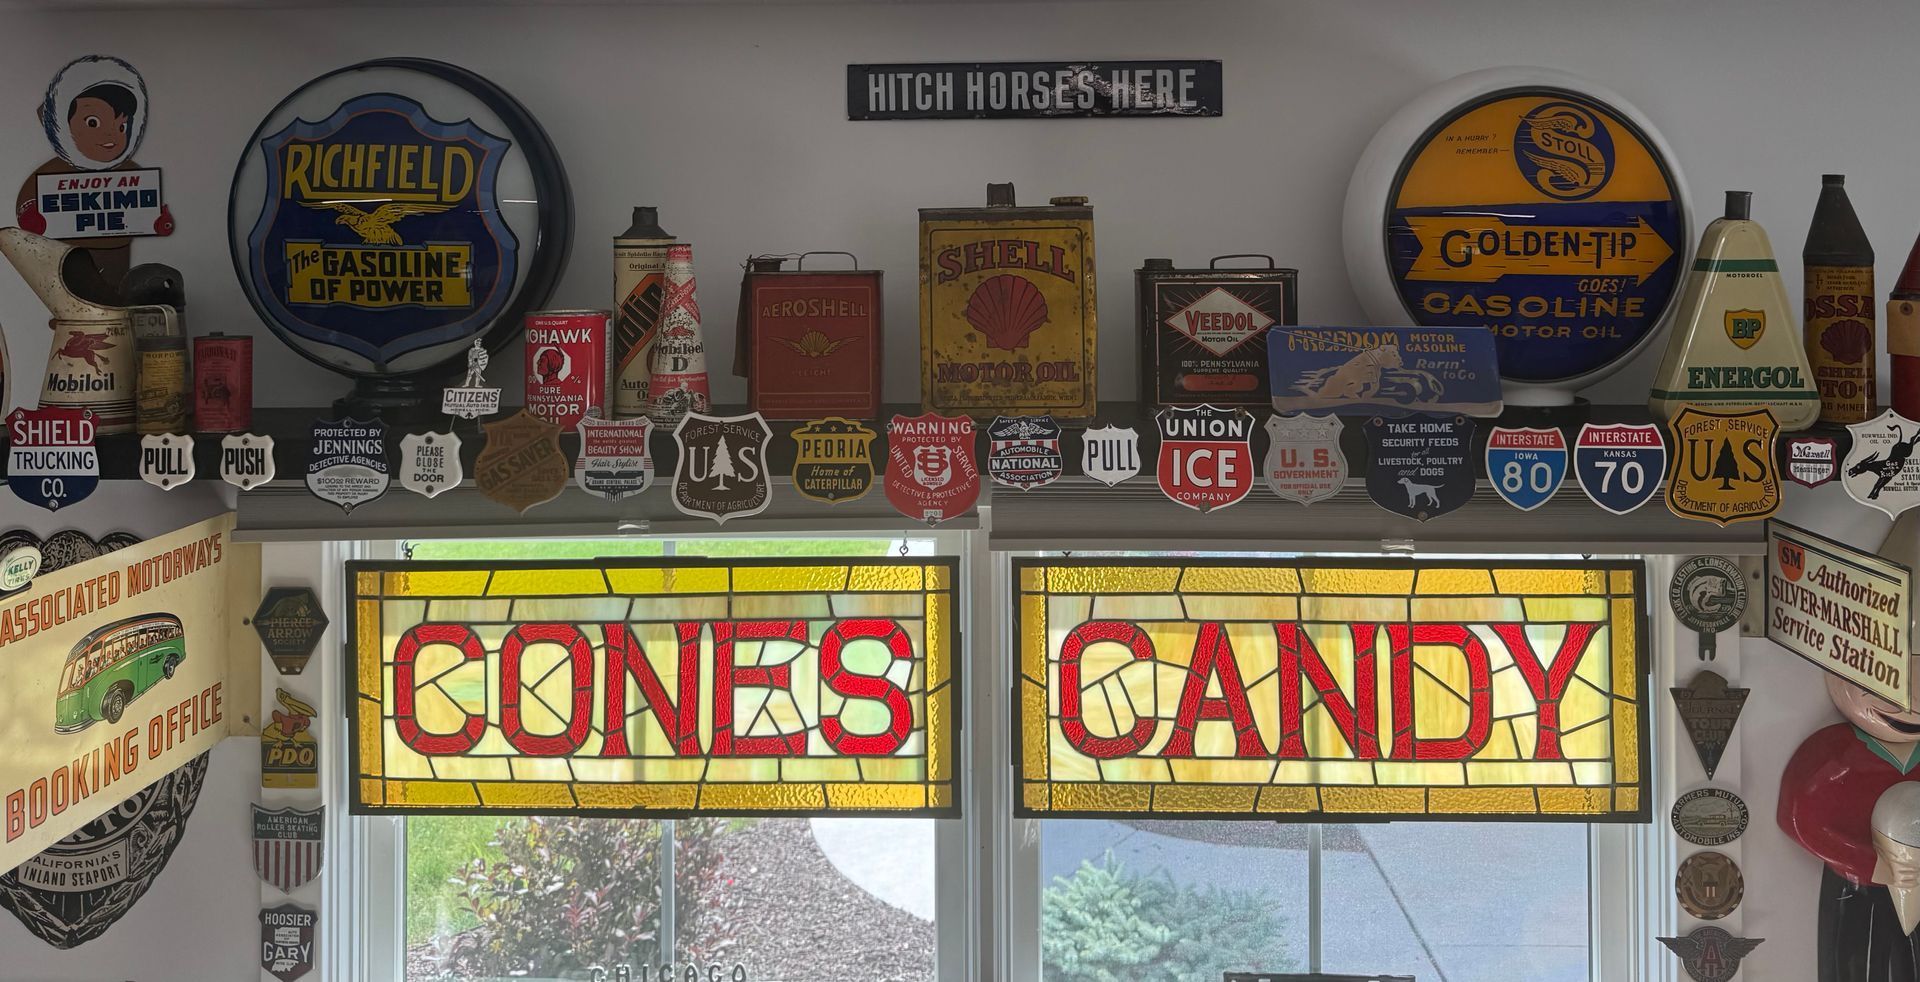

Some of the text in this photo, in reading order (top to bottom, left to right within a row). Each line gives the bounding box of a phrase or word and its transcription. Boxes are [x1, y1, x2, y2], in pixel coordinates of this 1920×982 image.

[868, 69, 1198, 112] HITCH HORSES HERE
[1541, 132, 1595, 163] STOLL
[285, 144, 474, 202] RICHFIELD
[58, 176, 140, 190] ENJOY AN
[42, 189, 158, 213] ESKIMO
[1440, 230, 1637, 268] GOLDEN-TIP
[292, 250, 462, 278] The GASOLINE
[937, 240, 1075, 284] SHELL
[310, 279, 444, 302] OF POWER
[1577, 279, 1627, 293] GOES!
[761, 298, 867, 318] AEROSHELL
[1423, 293, 1645, 318] GASOLINE
[1185, 310, 1257, 336] VEEDOL
[1489, 325, 1622, 339] MOTOR OIL
[1732, 318, 1761, 339] BP
[525, 328, 591, 343] MOHAWK
[1288, 330, 1454, 352] FREEDOM MOTOR
[1405, 344, 1466, 352] GASOLINE
[672, 357, 688, 371] D
[937, 362, 1079, 384] MOTOR OIL
[47, 373, 115, 392] Mobiloil
[621, 379, 648, 389] Auto
[1687, 366, 1805, 389] ENERGOL
[446, 390, 498, 402] CITIZENS
[528, 394, 583, 402] PENNSYLVANIA
[529, 404, 579, 416] MOTOR
[14, 420, 94, 445] SHIELD
[314, 428, 381, 437] PROTECTED BY
[685, 424, 761, 443] FOREST SERVICE
[893, 422, 971, 434] WARNING
[1166, 419, 1242, 437] UNION
[1387, 423, 1453, 433] TAKE HOME
[1589, 431, 1651, 443] INTERSTATE
[1684, 419, 1769, 439] FOREST SERVICE
[313, 439, 382, 455] JENNINGS
[802, 439, 866, 458] PEORIA
[1382, 438, 1459, 447] SECURITY FEEDS
[1496, 434, 1555, 446] INTERSTATE
[417, 446, 444, 456] PLEASE
[588, 446, 642, 454] BEAUTY SHOW
[1001, 446, 1049, 456] AUTOMOBILE
[1088, 440, 1136, 471] PULL
[1281, 449, 1336, 468] U. S.
[1515, 452, 1538, 460] IOWA
[1604, 450, 1637, 458] KANSAS
[14, 451, 94, 470] TRUCKING
[144, 447, 188, 475] PULL
[225, 447, 265, 475] PUSH
[309, 455, 387, 472] DETECTIVE AGENCIES
[416, 457, 444, 468] CLOSE
[689, 447, 758, 482] U S
[891, 445, 977, 481] UNITED SERVICE
[992, 458, 1058, 469] NATIONAL
[1171, 448, 1238, 488] ICE
[1379, 457, 1463, 466] LIVESTOCK, POULTRY
[1688, 439, 1767, 483] U S
[414, 474, 444, 482] DOOR
[811, 465, 856, 476] Home of
[1000, 471, 1052, 480] ASSOCIATION
[1274, 470, 1339, 479] GOVERNMENT
[1398, 467, 1444, 476] and DOGS
[1502, 461, 1552, 494] 80
[1595, 461, 1645, 494] 70
[41, 478, 67, 498] CO.
[805, 478, 863, 490] CATERPILLAR
[892, 480, 925, 499] DETECTIVE
[932, 482, 971, 499] PROTECTIVE
[679, 482, 765, 510] DEPARTMENT OF AGRICULTURE
[1176, 492, 1231, 501] COMPANY
[1677, 479, 1775, 512] DEPARTMENT OF AGRICULTURE
[8, 560, 33, 575] KELLY
[0, 533, 222, 648] ASSOCIATED MOTORWAYS
[1782, 547, 1900, 618] SM Authorized
[271, 618, 312, 627] PIERCE
[1772, 576, 1903, 657] SILVER-MARSHALL
[268, 629, 312, 638] ARROW
[1773, 606, 1900, 690] Service Station
[393, 618, 913, 757] CONES
[1059, 620, 1601, 761] CANDY
[6, 727, 138, 843] BOOKING
[148, 682, 222, 760] OFFICE
[268, 747, 314, 765] PDQ
[1674, 790, 1747, 815] FARMERS MUTUAL
[1673, 818, 1725, 845] AUTOMOBILE
[29, 851, 120, 869] ALIFORNIA'S
[23, 864, 121, 887] INLAND SEAPORT
[265, 913, 311, 926] HOOSIER
[263, 941, 311, 962] GARY
[590, 963, 747, 982] CHICAGO
